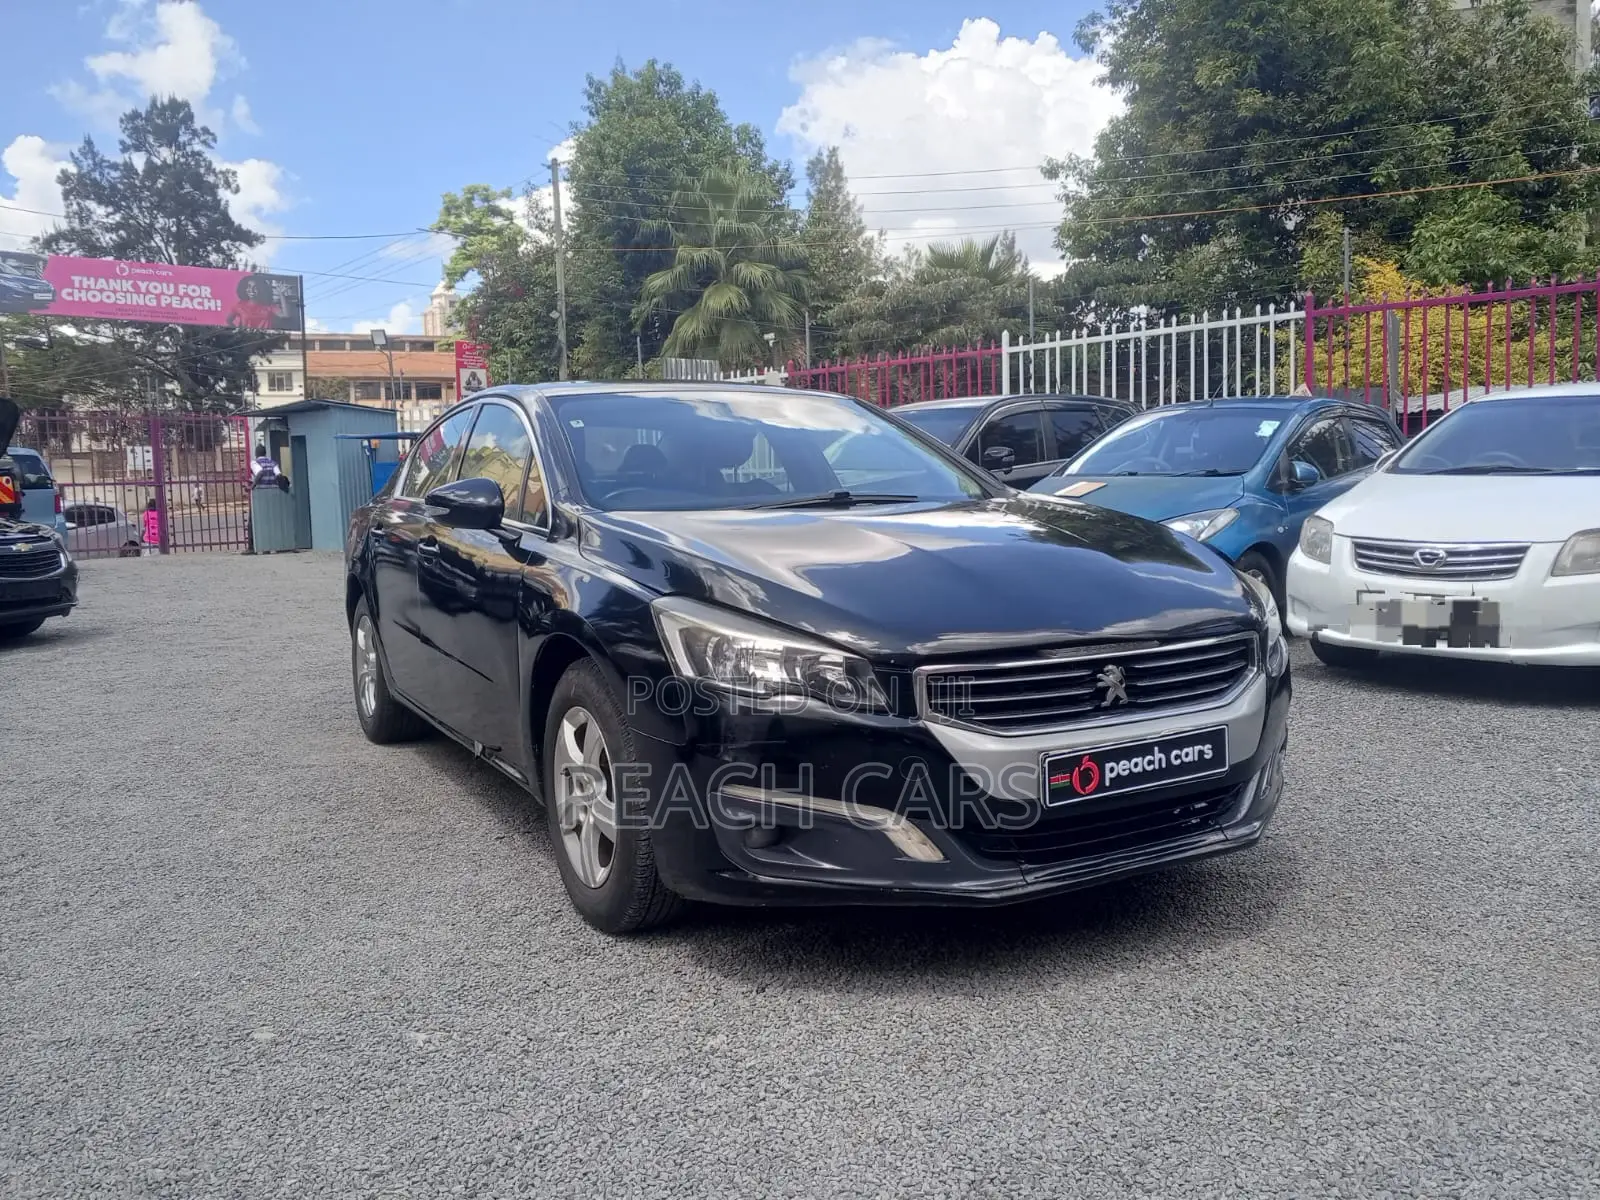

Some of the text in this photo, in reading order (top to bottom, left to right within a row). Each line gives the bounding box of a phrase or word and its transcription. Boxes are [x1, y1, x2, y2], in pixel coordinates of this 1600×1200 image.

[70, 275, 212, 298] THANK YOU FOR
[60, 287, 157, 307] CHOOSING
[160, 294, 222, 312] PEACH!
[1104, 743, 1214, 786] peach cars
